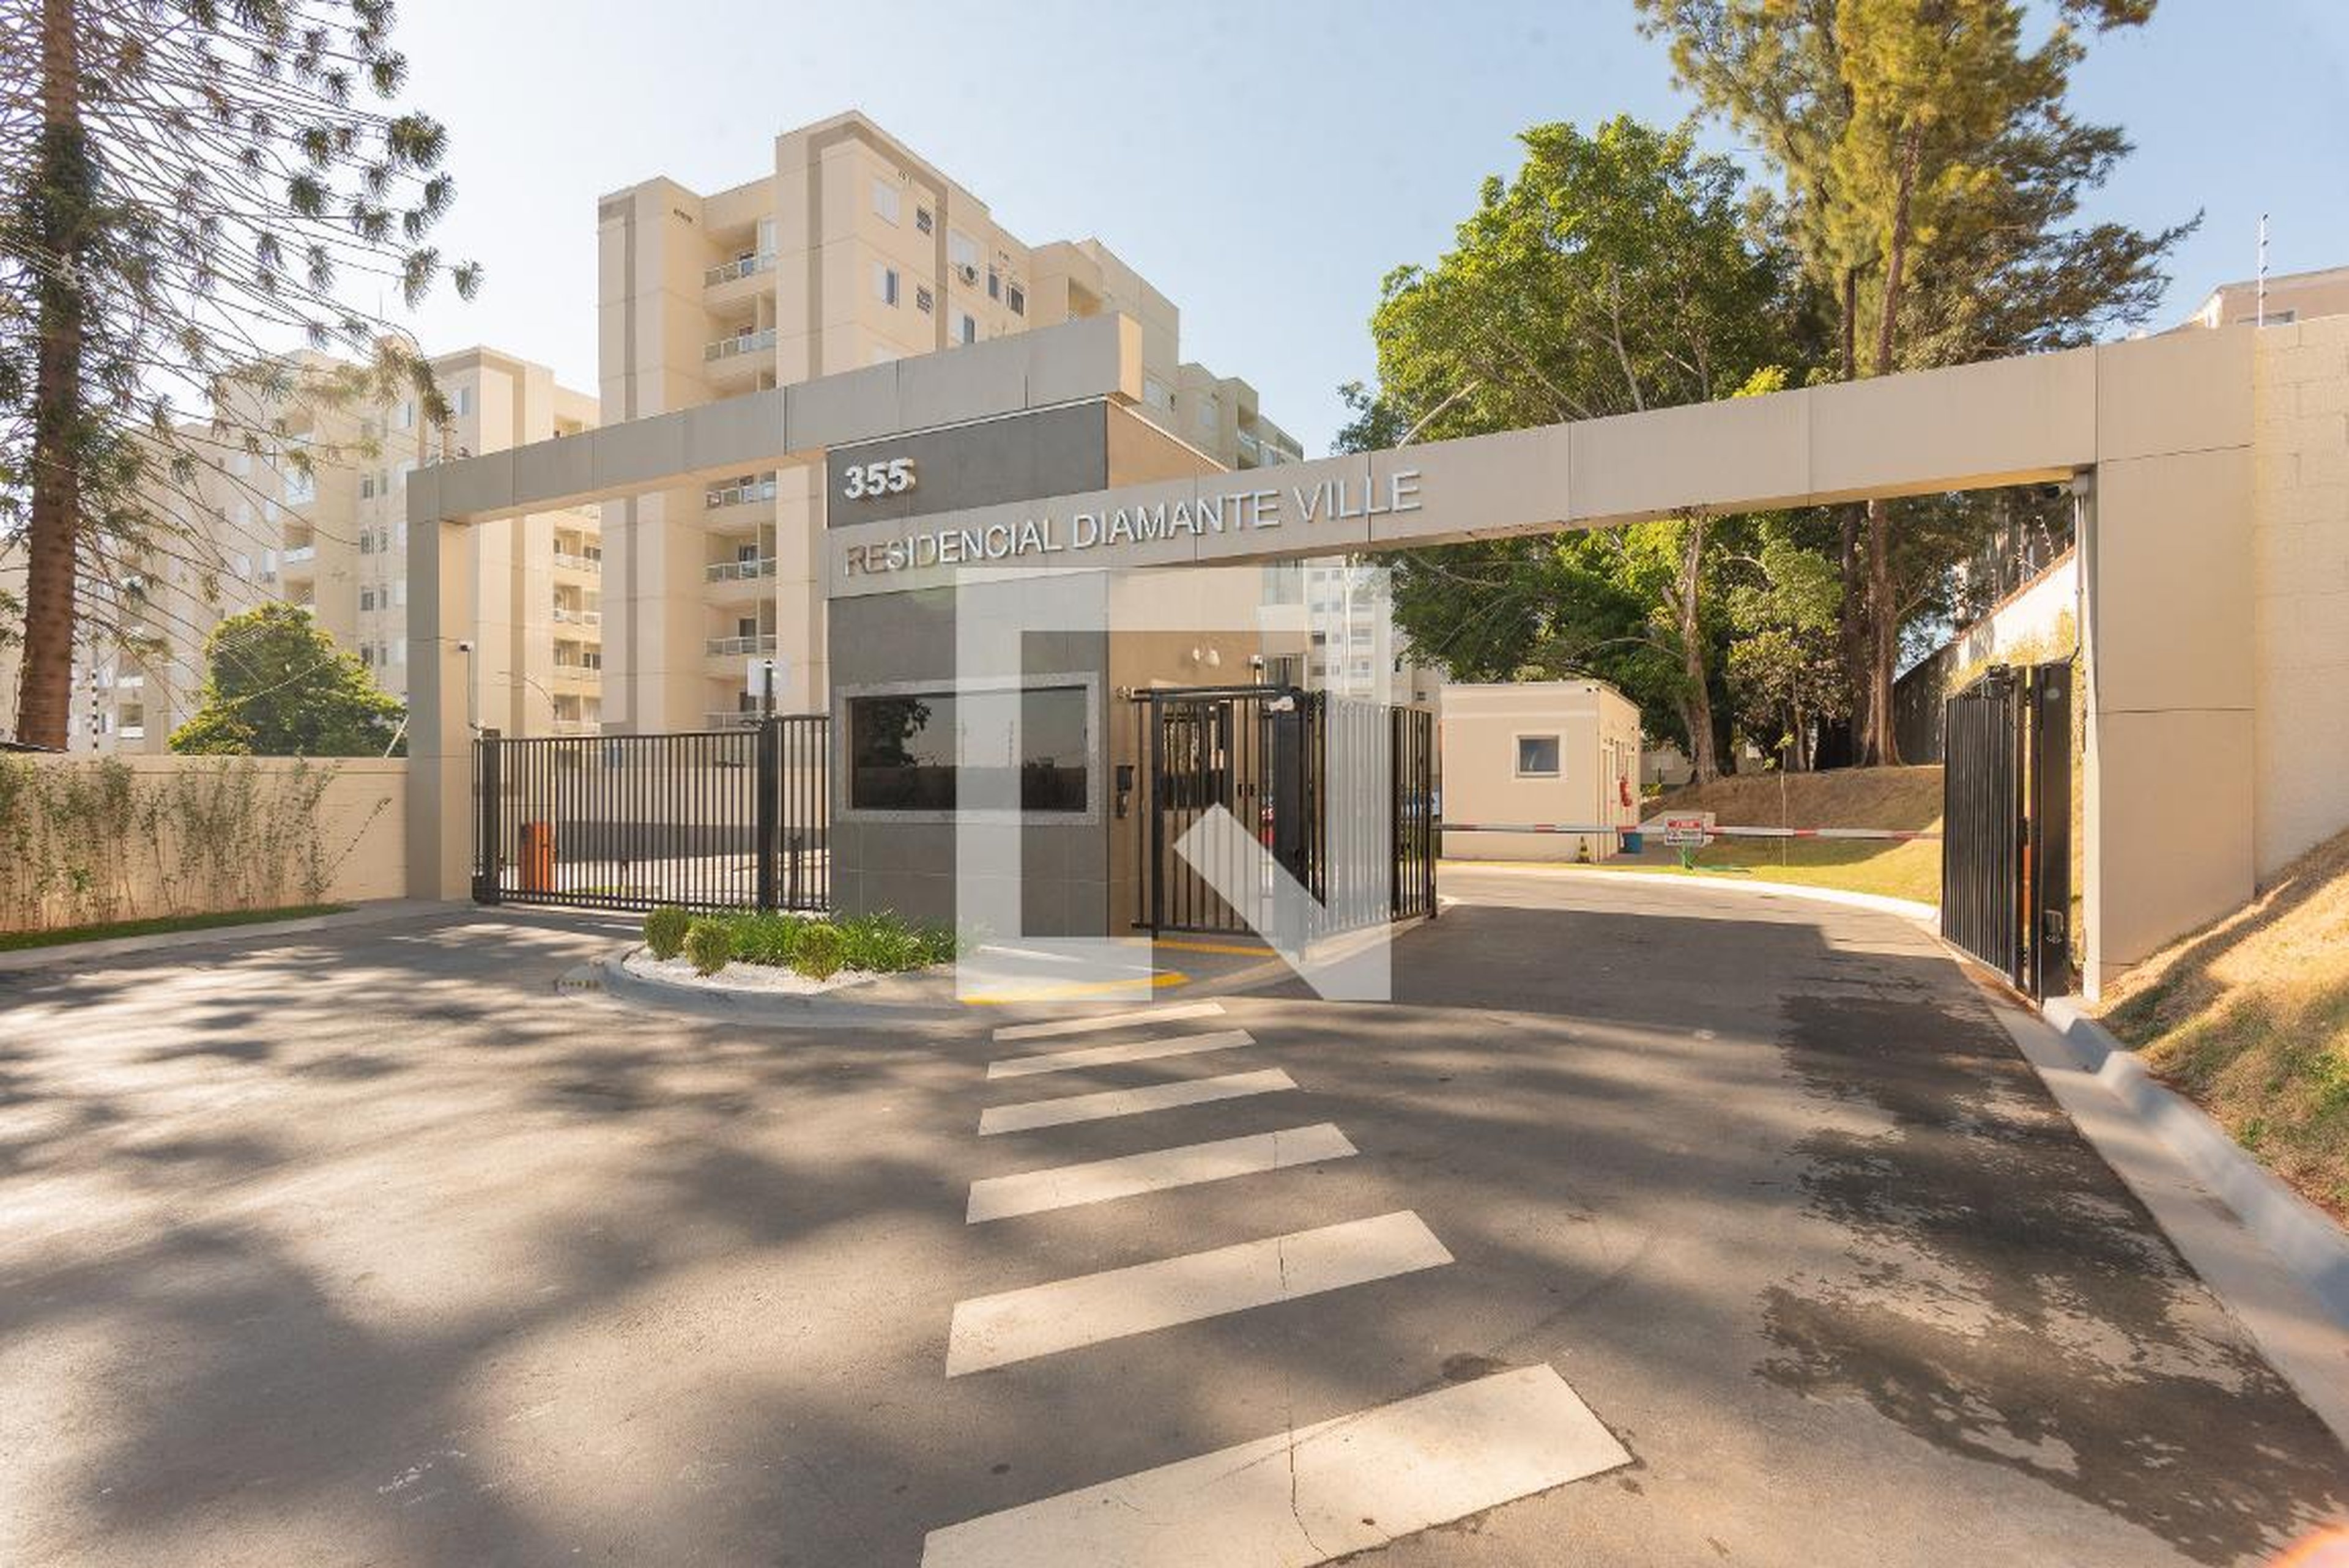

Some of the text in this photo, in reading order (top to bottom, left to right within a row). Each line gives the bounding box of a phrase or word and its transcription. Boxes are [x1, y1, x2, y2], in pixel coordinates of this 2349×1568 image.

[845, 457, 916, 498] 355
[845, 471, 1422, 576] RESIDENCIAL DIAMANTE VILLE
